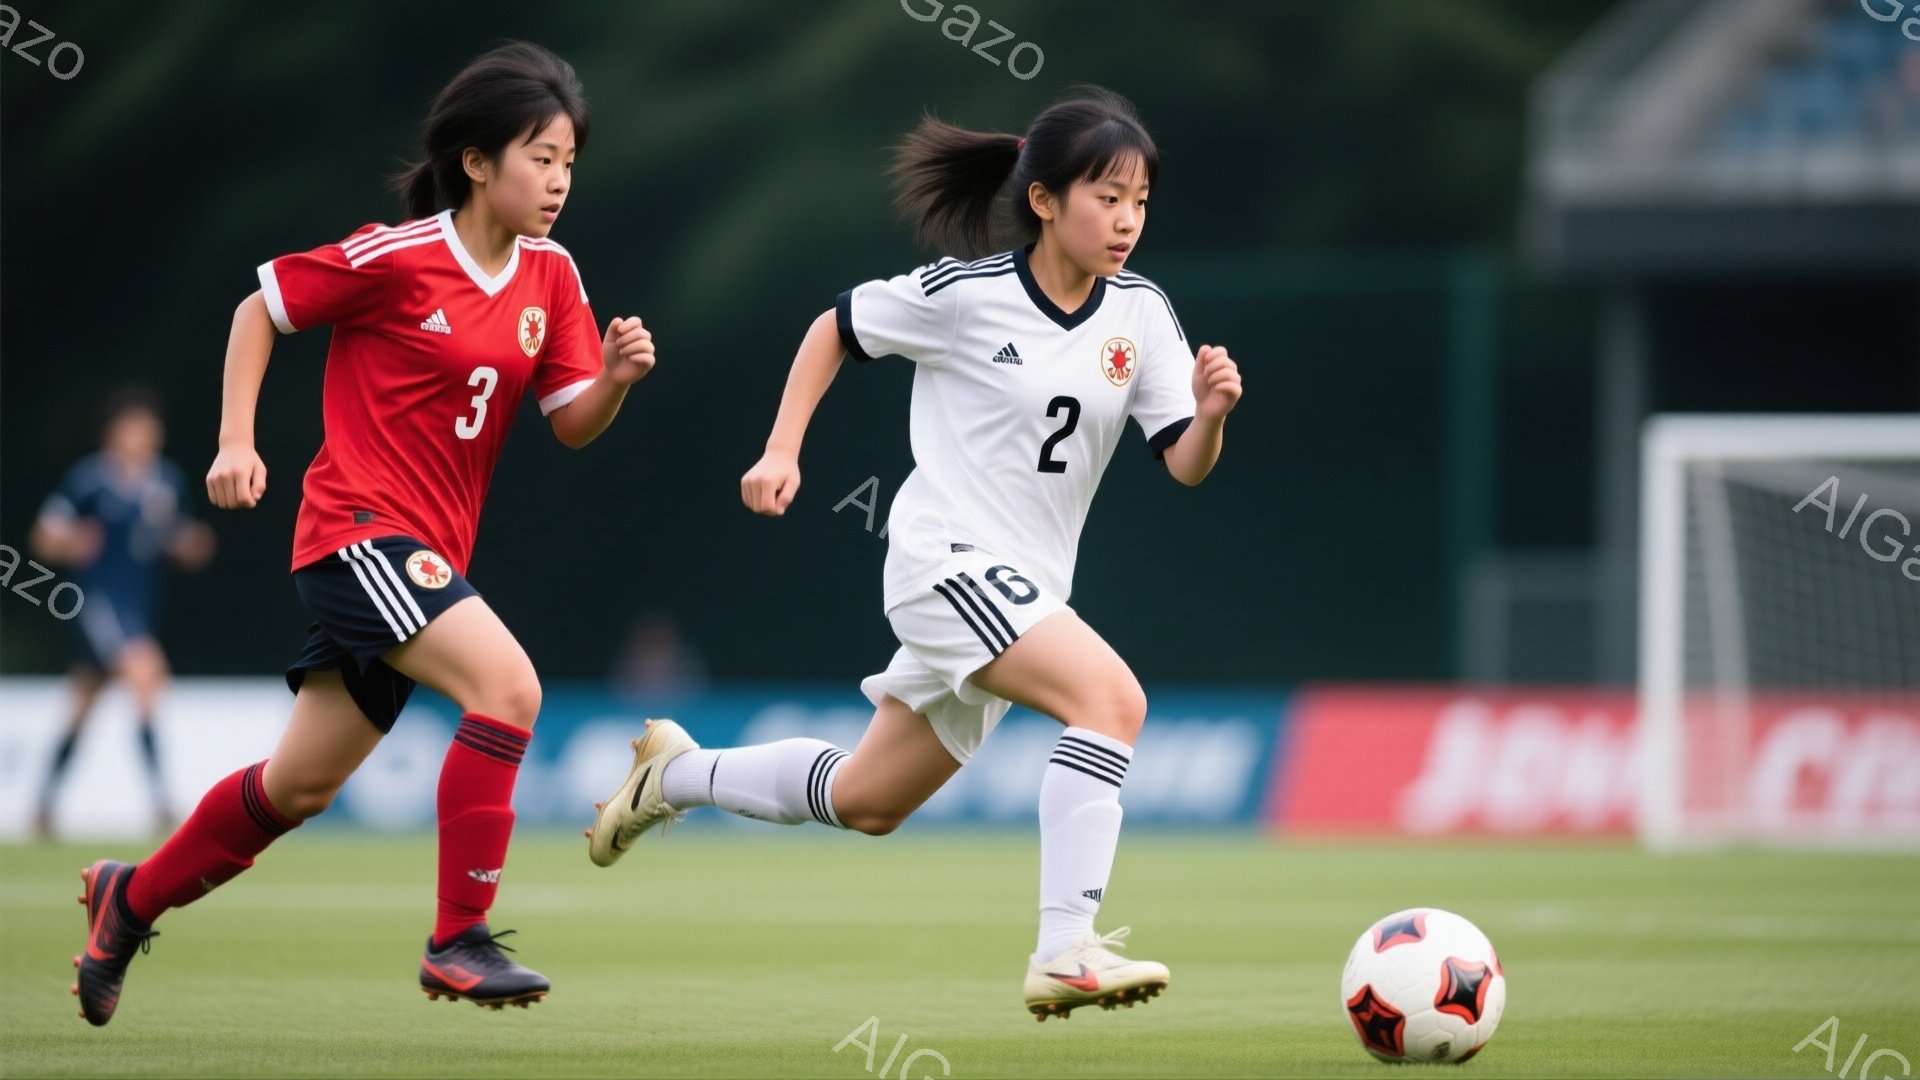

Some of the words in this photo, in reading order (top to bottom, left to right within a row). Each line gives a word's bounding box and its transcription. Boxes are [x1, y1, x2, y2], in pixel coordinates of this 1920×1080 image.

[455, 366, 498, 439] 3
[1037, 396, 1081, 473] 2
[984, 564, 1040, 605] 6
